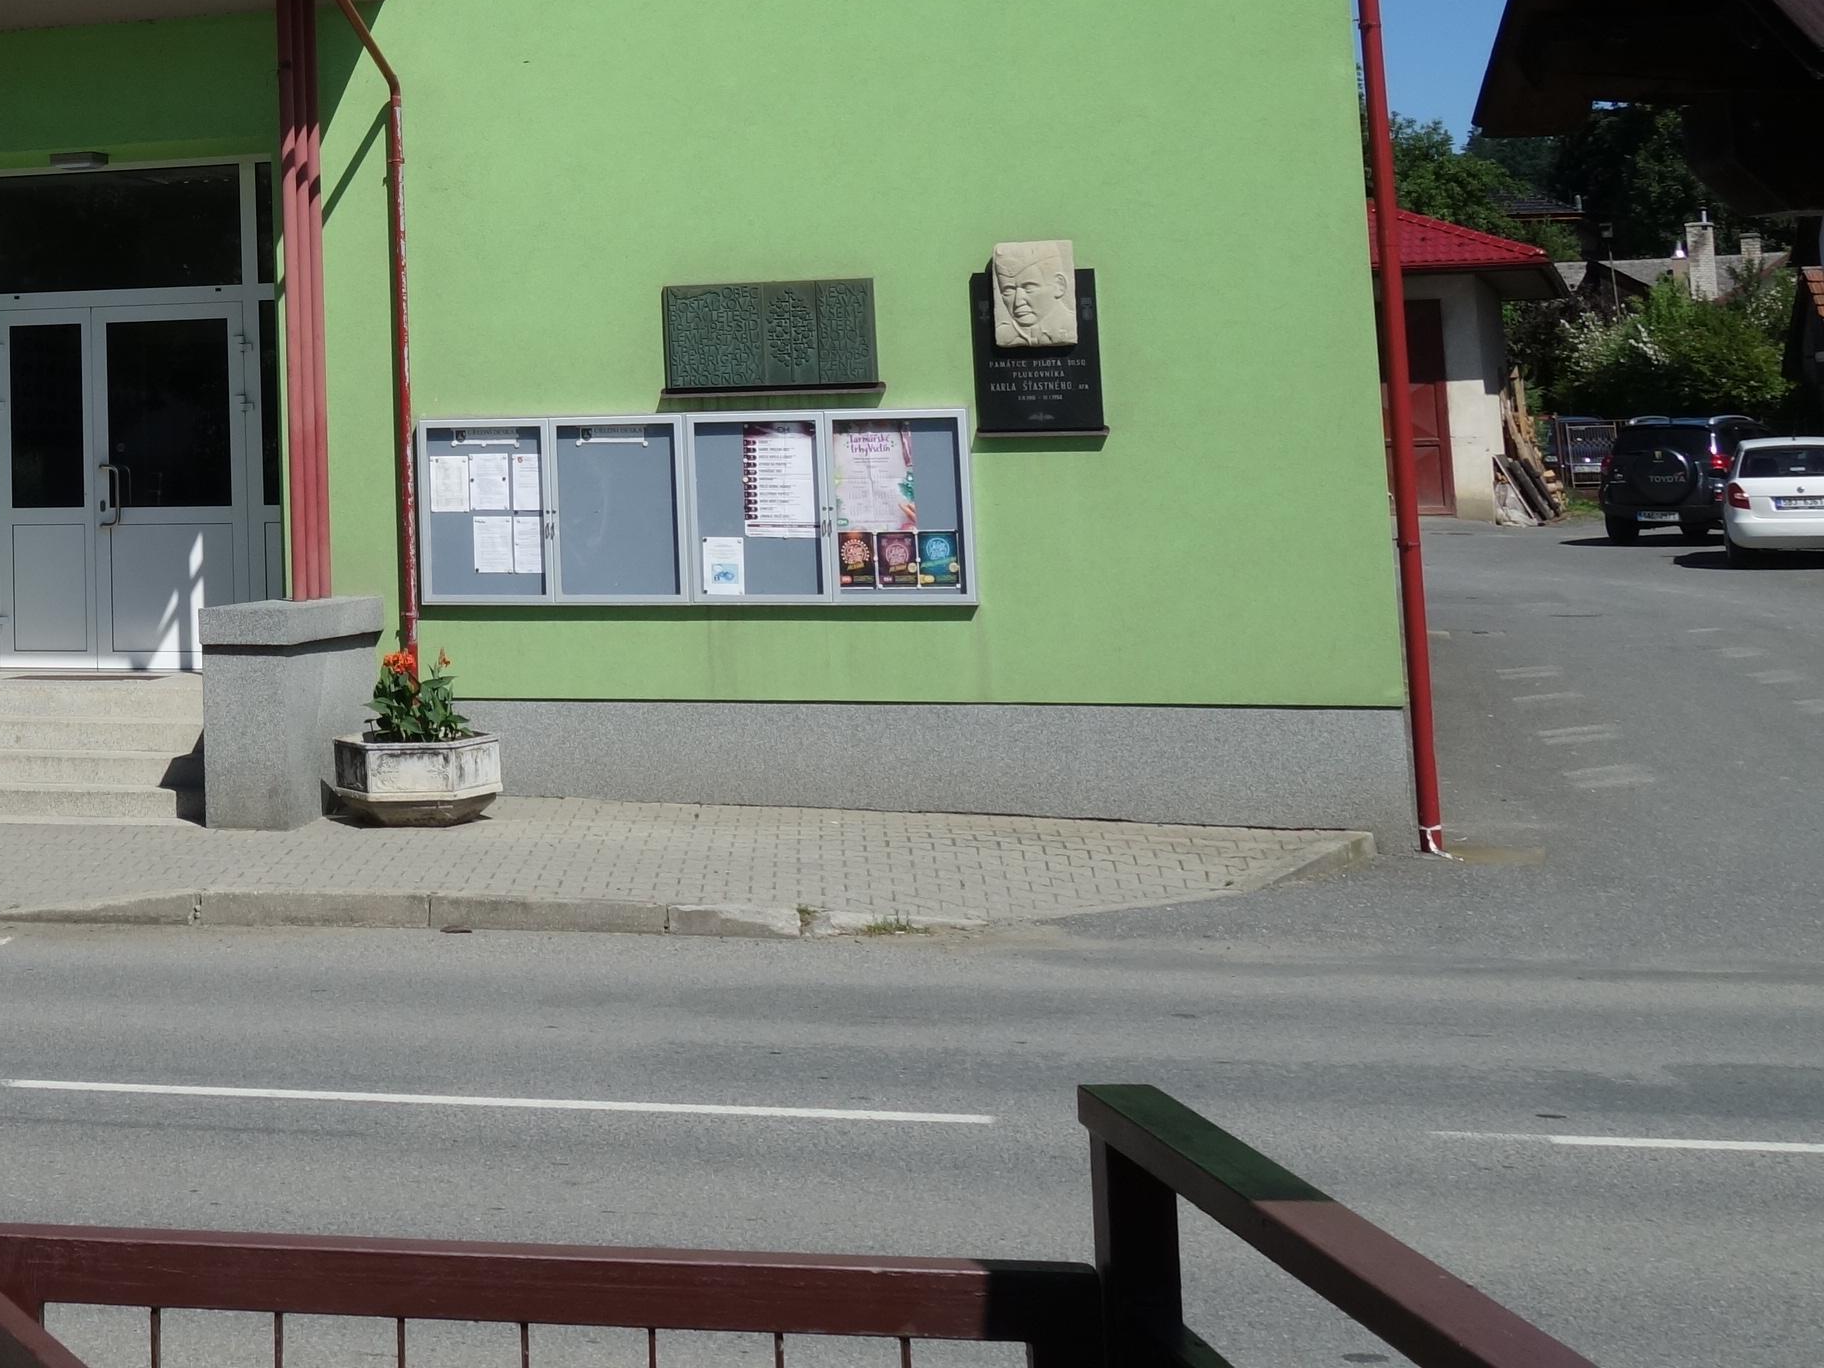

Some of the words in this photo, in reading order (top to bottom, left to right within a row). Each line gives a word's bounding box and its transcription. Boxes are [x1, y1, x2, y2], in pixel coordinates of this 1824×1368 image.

[1033, 359, 1062, 367] PILOTA
[991, 383, 1016, 391] KARLA
[1648, 474, 1686, 483] TOYOTA
